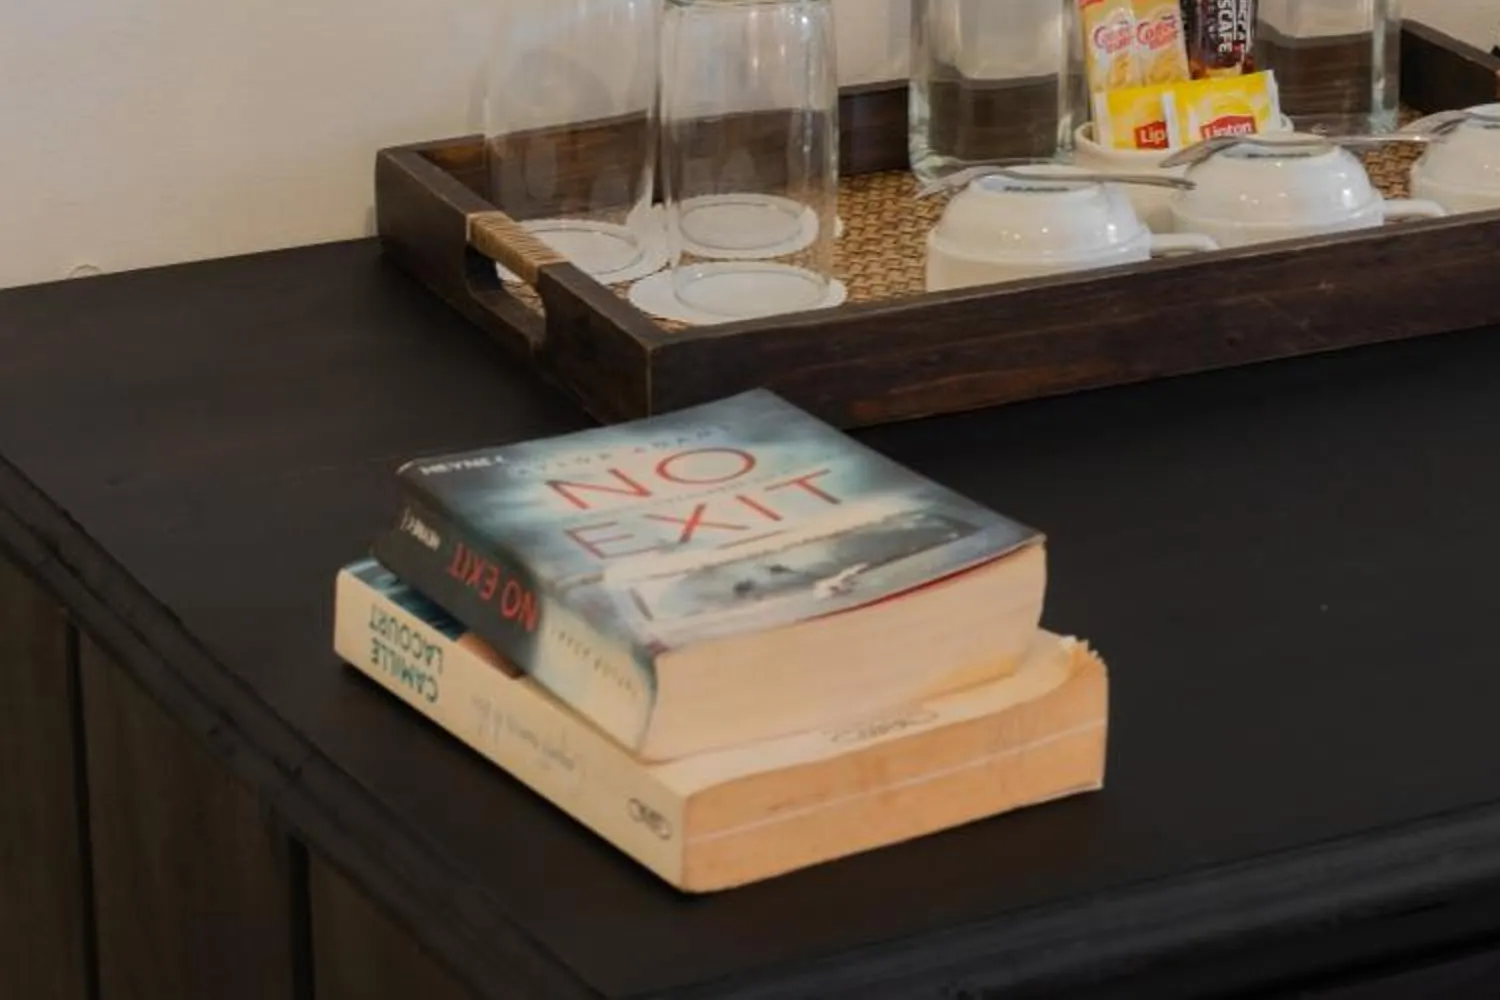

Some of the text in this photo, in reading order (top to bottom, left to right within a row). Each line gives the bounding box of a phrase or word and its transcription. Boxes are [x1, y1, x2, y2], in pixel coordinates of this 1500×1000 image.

[1140, 126, 1165, 145] Lip
[544, 446, 756, 511] NO
[563, 468, 842, 560] EXIT
[448, 541, 539, 633] NO EXIT
[369, 602, 444, 674] LACOURT
[371, 637, 439, 704] CAMILLE
